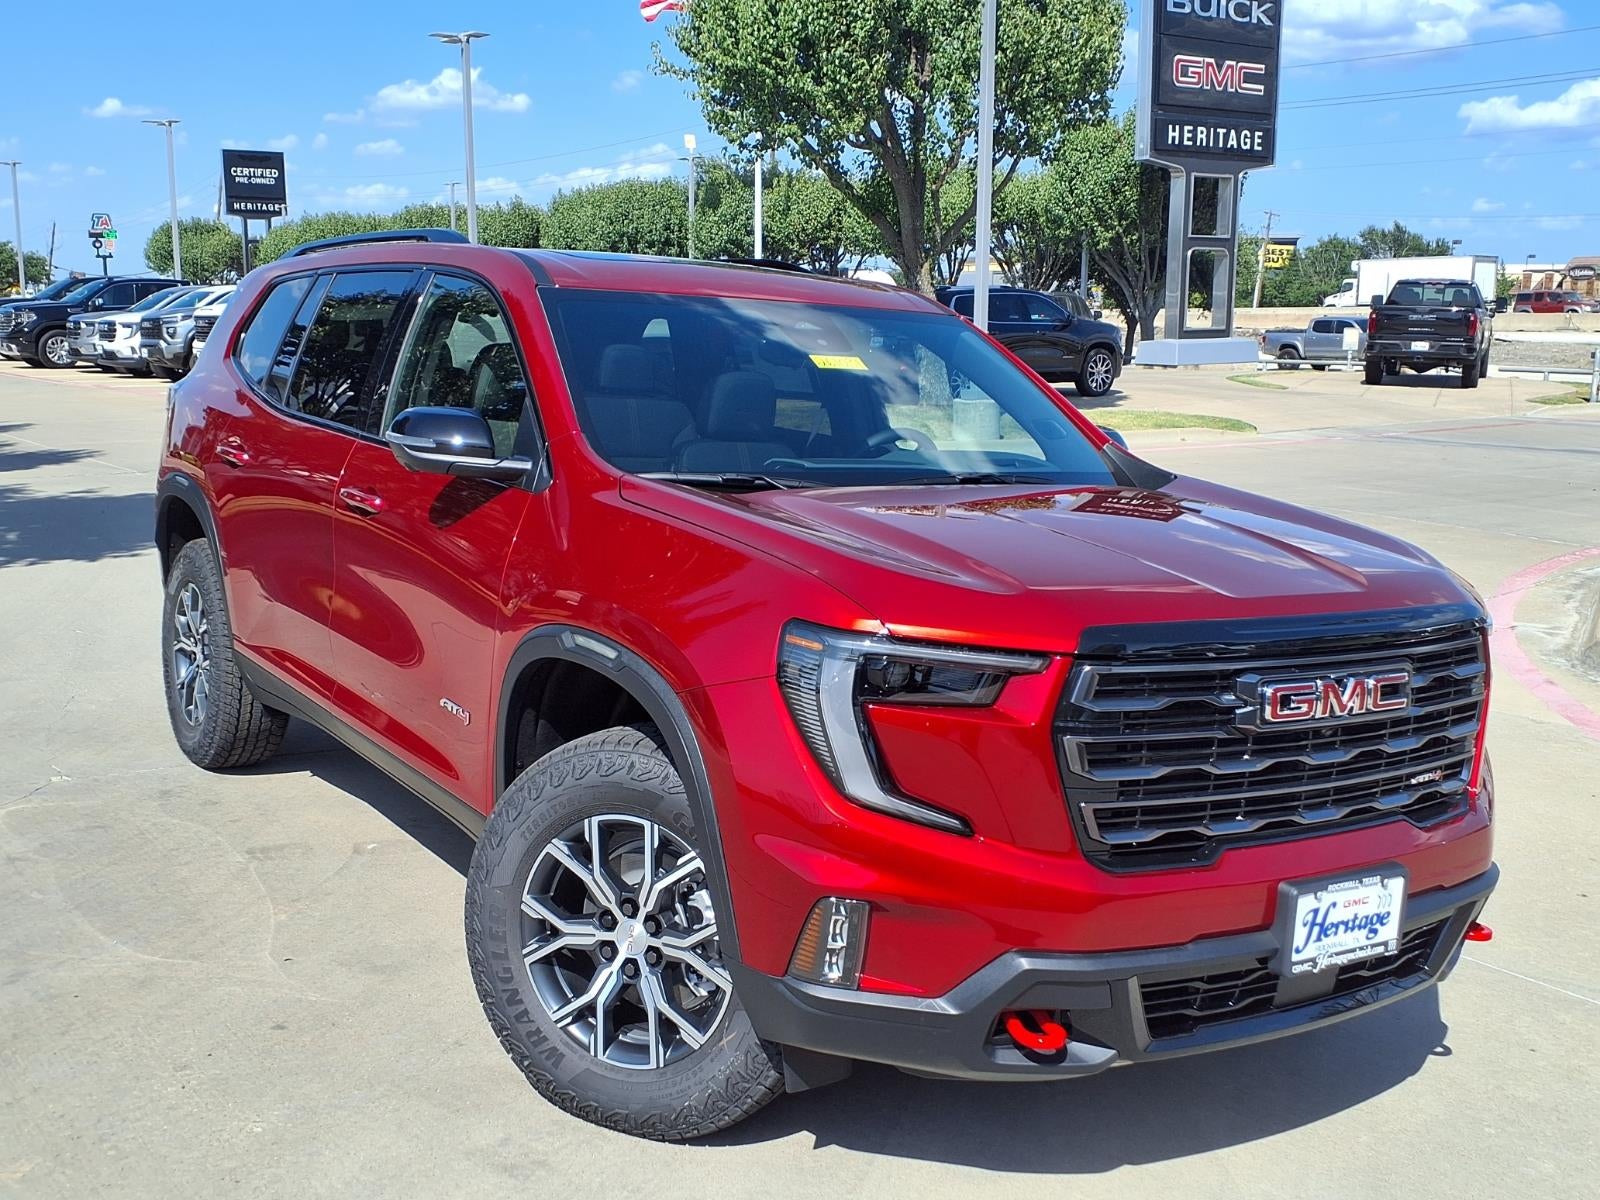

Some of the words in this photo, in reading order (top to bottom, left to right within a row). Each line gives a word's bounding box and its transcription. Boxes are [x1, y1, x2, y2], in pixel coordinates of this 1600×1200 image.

[1166, 0, 1274, 26] BUICK
[1173, 54, 1265, 96] GMC
[1167, 124, 1264, 151] HERITAGE
[230, 167, 279, 178] CERTIFIED
[234, 177, 276, 185] PRE-OWNED
[92, 214, 112, 229] TA
[1264, 256, 1290, 265] BUY
[1265, 672, 1408, 722] GMC
[440, 698, 470, 726] AT4
[1343, 896, 1370, 908] GMC
[1294, 901, 1391, 954] Heritage
[1291, 961, 1313, 973] GMC
[488, 903, 567, 1070] WRANGLER
